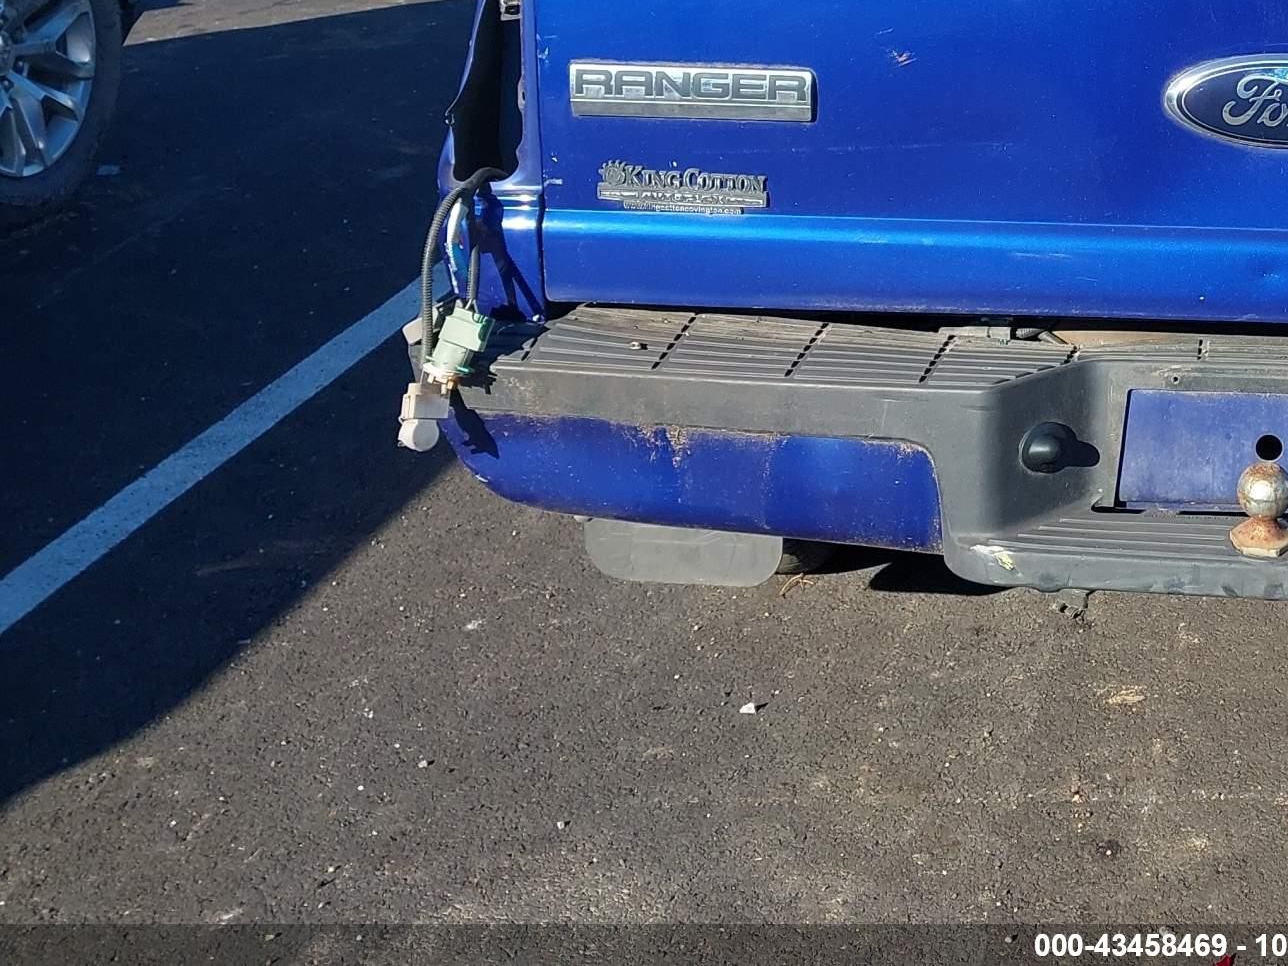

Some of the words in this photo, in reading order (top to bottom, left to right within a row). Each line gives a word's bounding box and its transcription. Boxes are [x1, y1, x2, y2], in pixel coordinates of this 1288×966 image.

[574, 67, 808, 103] RANGER
[625, 165, 682, 188] KING
[683, 168, 767, 193] COTTON
